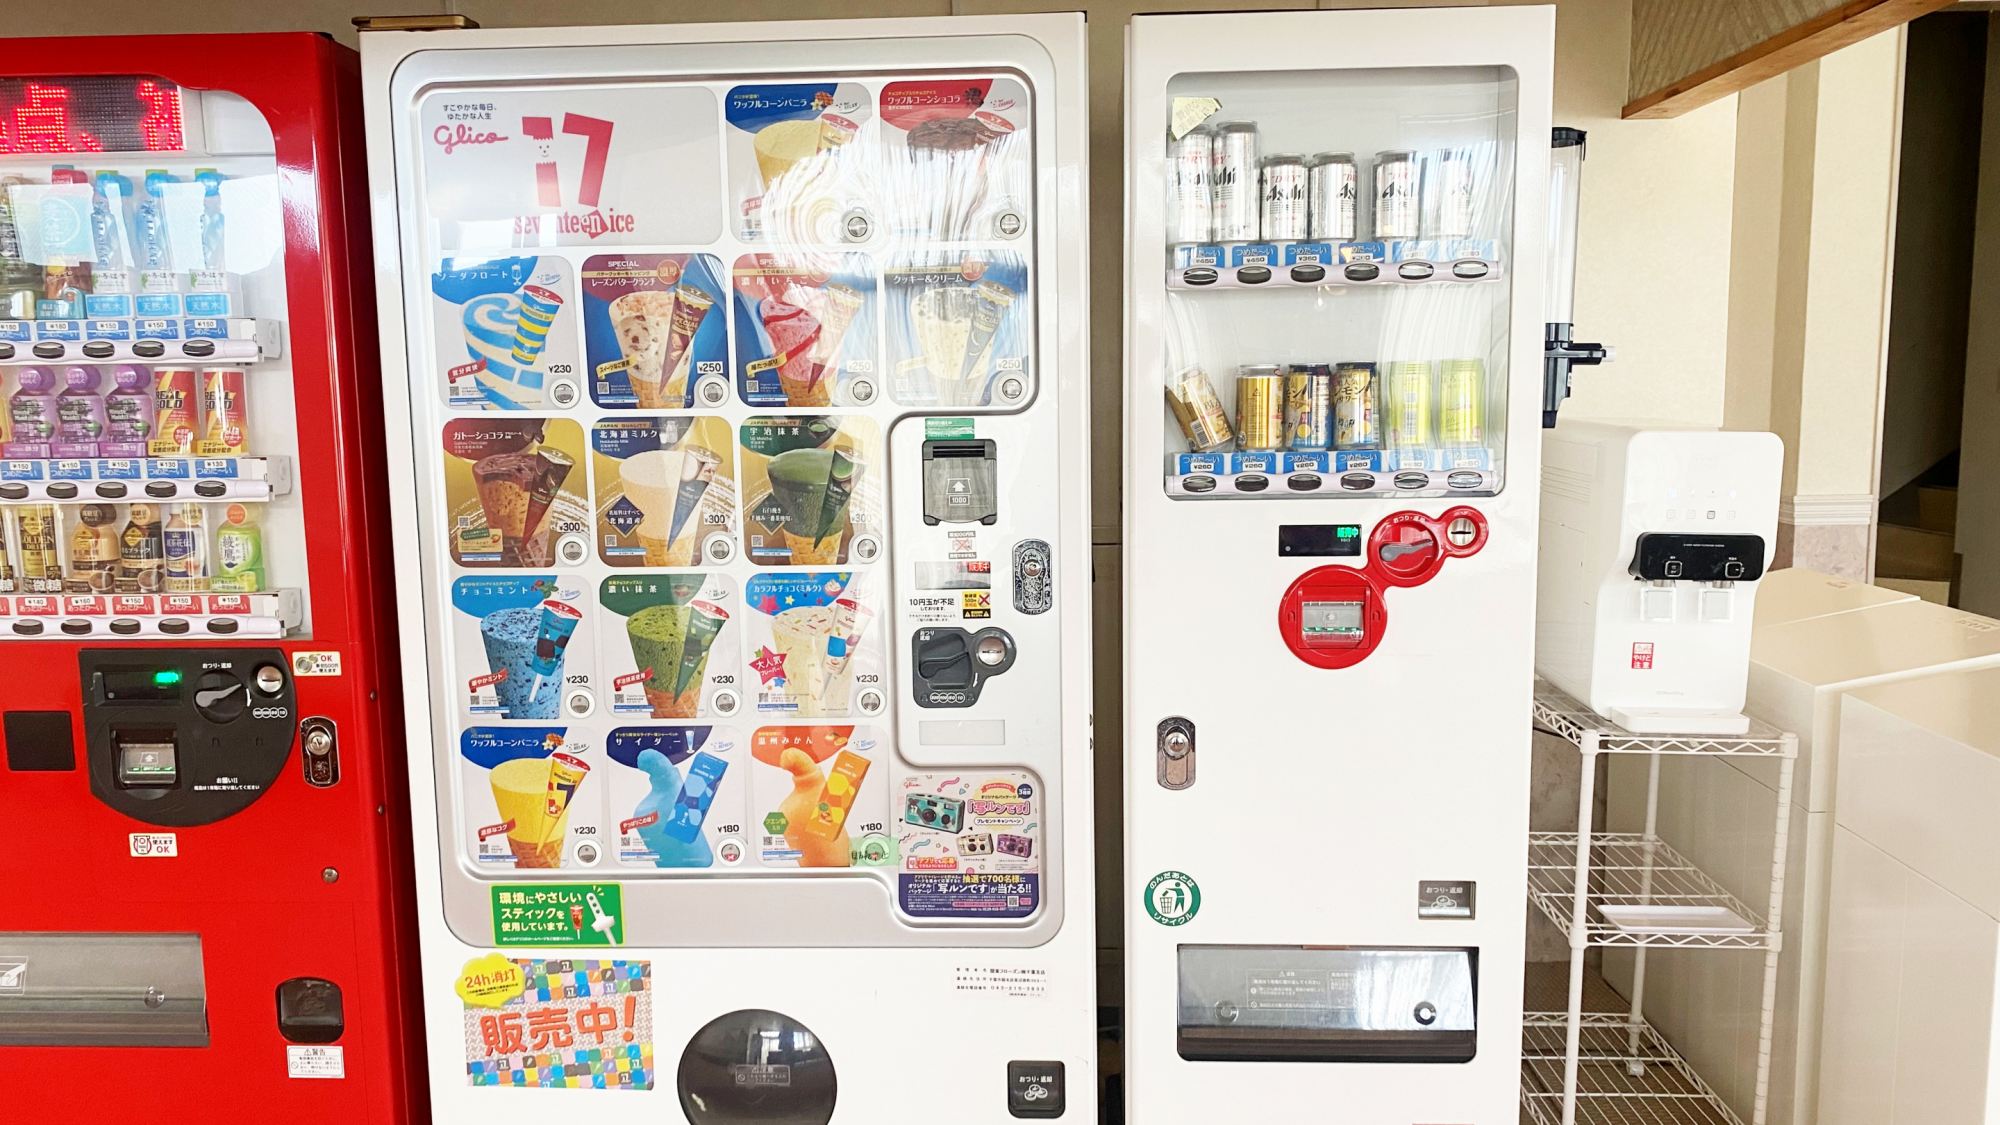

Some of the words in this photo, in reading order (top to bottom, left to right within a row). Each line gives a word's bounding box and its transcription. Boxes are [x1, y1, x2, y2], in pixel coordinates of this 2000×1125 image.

[733, 98, 808, 109] ワッフルコーンバニラ
[887, 95, 961, 105] ワッフルコーンショコラ
[443, 102, 497, 112] すこやかな毎日、
[447, 112, 492, 120] ゆたかな人生
[433, 124, 509, 155] Glico
[521, 112, 615, 208] 17
[609, 208, 635, 233] ice
[548, 364, 572, 374] ¥230
[698, 363, 722, 373] ¥250
[453, 432, 504, 441] ガトーショコラ
[599, 430, 658, 439] 北海道ミルク
[749, 427, 800, 436] 宇治抹茶
[704, 514, 726, 524] ¥300
[559, 522, 581, 532] ¥300
[460, 586, 529, 596] チョコミント
[608, 585, 658, 594] 濃い抹茶
[908, 598, 955, 606] 10円玉が不足
[320, 654, 333, 662] OK
[755, 655, 782, 670] 大人気
[566, 675, 589, 684] ¥230
[711, 675, 735, 685] ¥230
[856, 674, 879, 684] ¥230
[470, 738, 540, 748] ワッフルコーンバニラ
[615, 737, 681, 746] サイダー
[758, 736, 814, 745] 温州みかん
[574, 826, 597, 836] ¥230
[717, 824, 740, 834] ¥180
[860, 822, 883, 832] ¥180
[156, 845, 170, 854] OK
[1149, 872, 1195, 890] のんだあとは
[499, 892, 582, 905] 環境にやさしい
[501, 907, 565, 920] スティックを
[1153, 911, 1194, 926] リサイクル
[501, 922, 569, 932] 使用しています。
[464, 968, 517, 989] 24h消灯
[480, 995, 637, 1057] 販売中!
